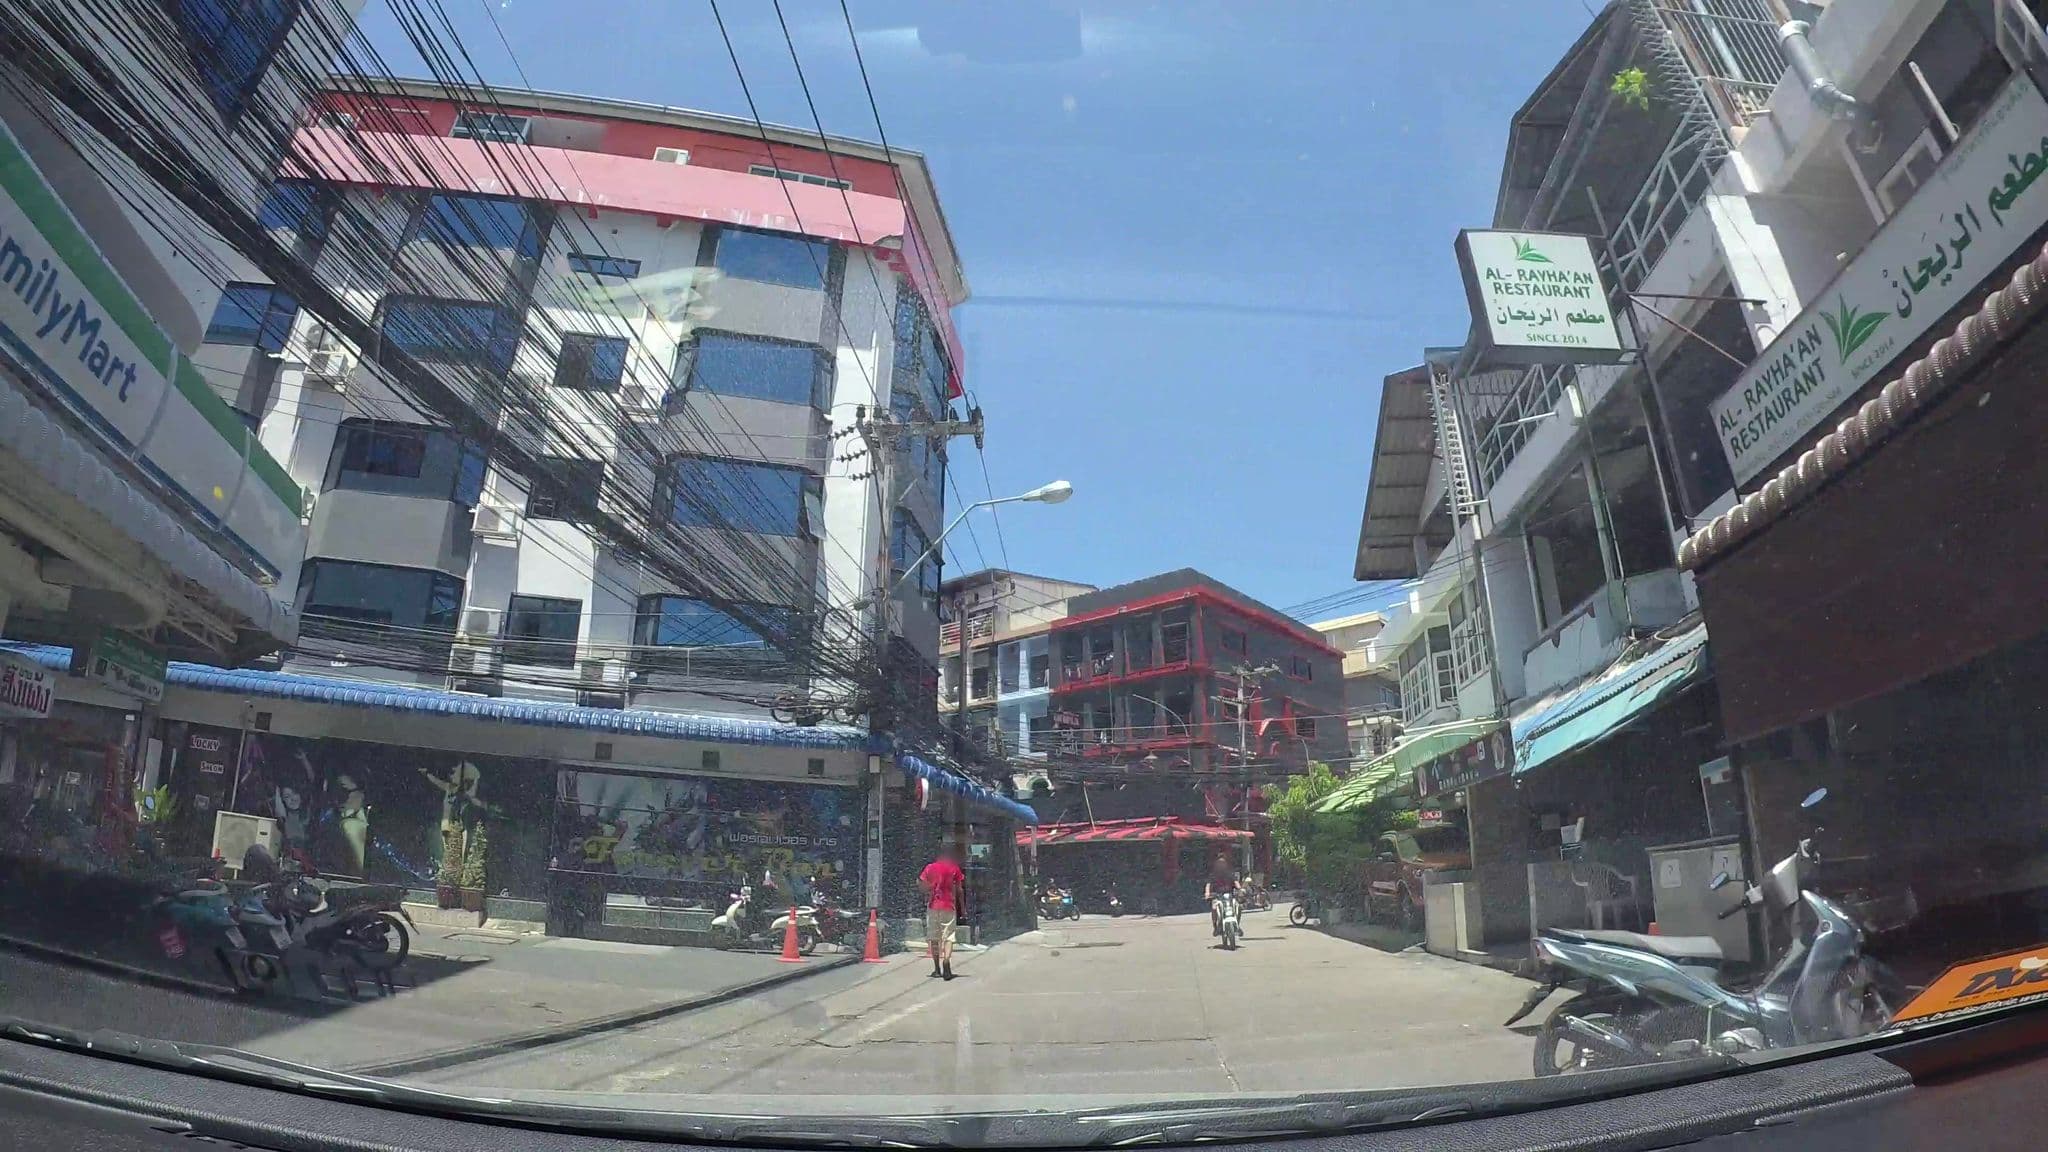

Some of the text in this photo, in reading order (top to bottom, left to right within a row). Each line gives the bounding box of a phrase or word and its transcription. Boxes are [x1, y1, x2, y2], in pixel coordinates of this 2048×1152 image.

[1517, 268, 1594, 285] RAYHA'AN
[1493, 282, 1592, 299] RESTAURANT
[0, 227, 137, 402] milyMart
[1565, 308, 1606, 328] مطعم
[1526, 333, 1588, 344] SINCE 2014
[1743, 323, 1823, 411] RAYHA'AN
[1729, 356, 1826, 459] RESTAURANT
[190, 735, 220, 751] LUCKY
